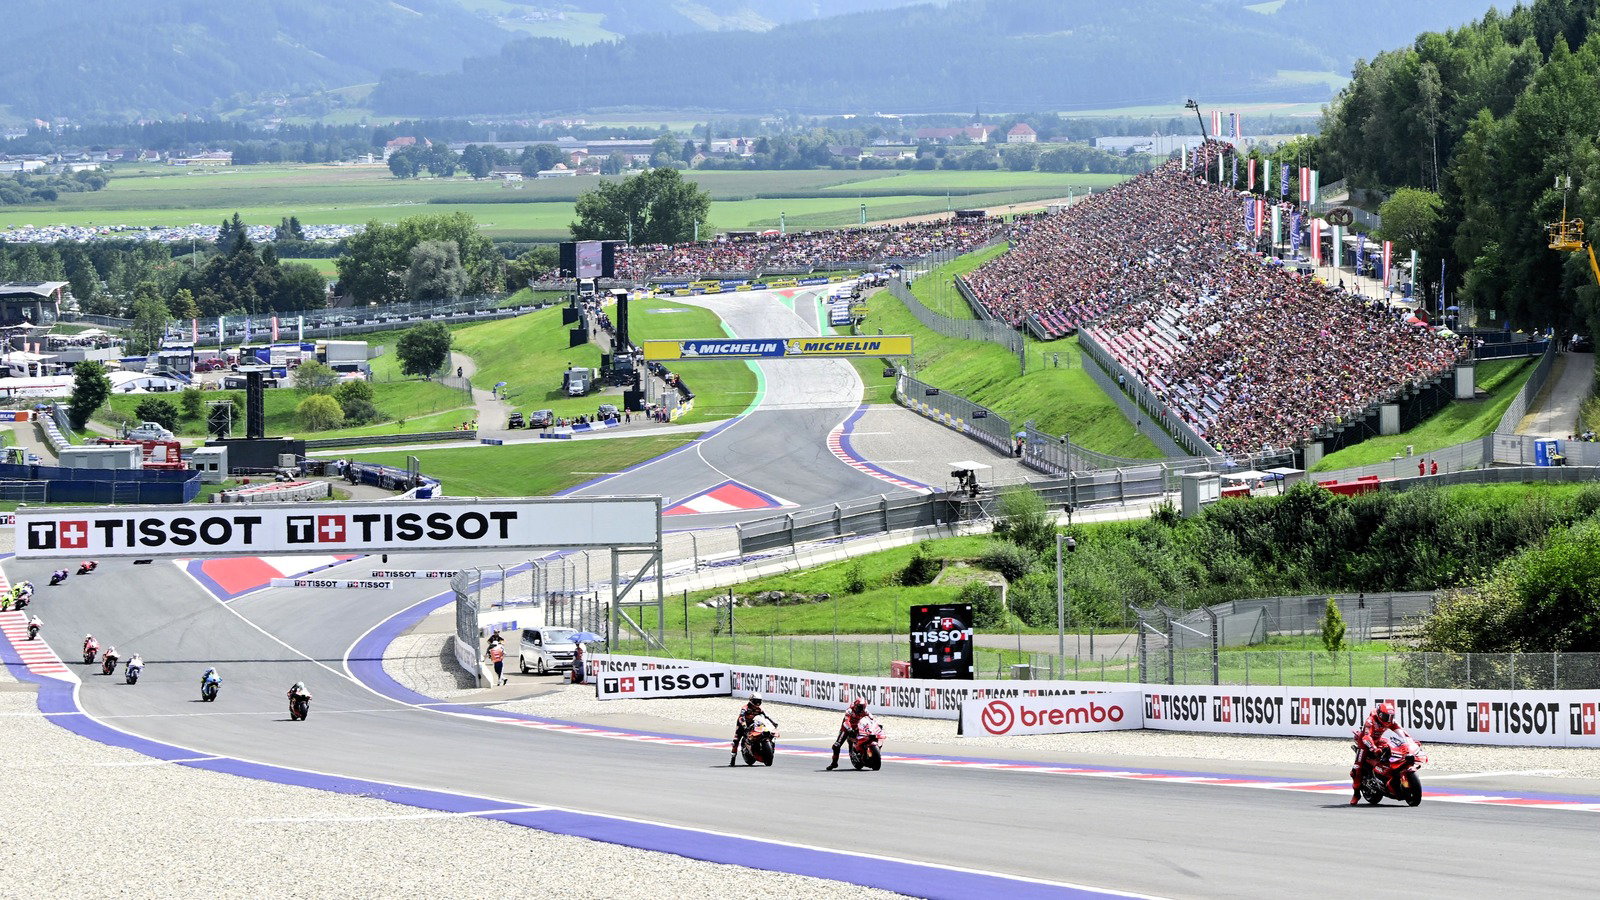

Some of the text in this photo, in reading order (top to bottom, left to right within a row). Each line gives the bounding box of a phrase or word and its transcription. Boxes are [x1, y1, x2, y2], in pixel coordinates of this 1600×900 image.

[699, 343, 777, 354] MICHELIN
[804, 341, 881, 352] MICHELIN
[94, 516, 262, 547] TISSOT
[353, 511, 518, 542] TISSOT
[912, 629, 973, 643] TISSOT
[638, 673, 724, 692] TISSOT
[741, 672, 763, 692] TISSOT
[774, 675, 798, 696] TISSOT
[810, 679, 836, 701] TISSOT
[891, 686, 921, 708] TISSOT
[1162, 695, 1207, 722] TISSOT
[1020, 701, 1124, 727] brembo
[1232, 696, 1284, 725] TISSOT
[1312, 698, 1366, 727] TISSOT
[1397, 699, 1458, 731] TISSOT
[1492, 702, 1560, 735] TISSOT
